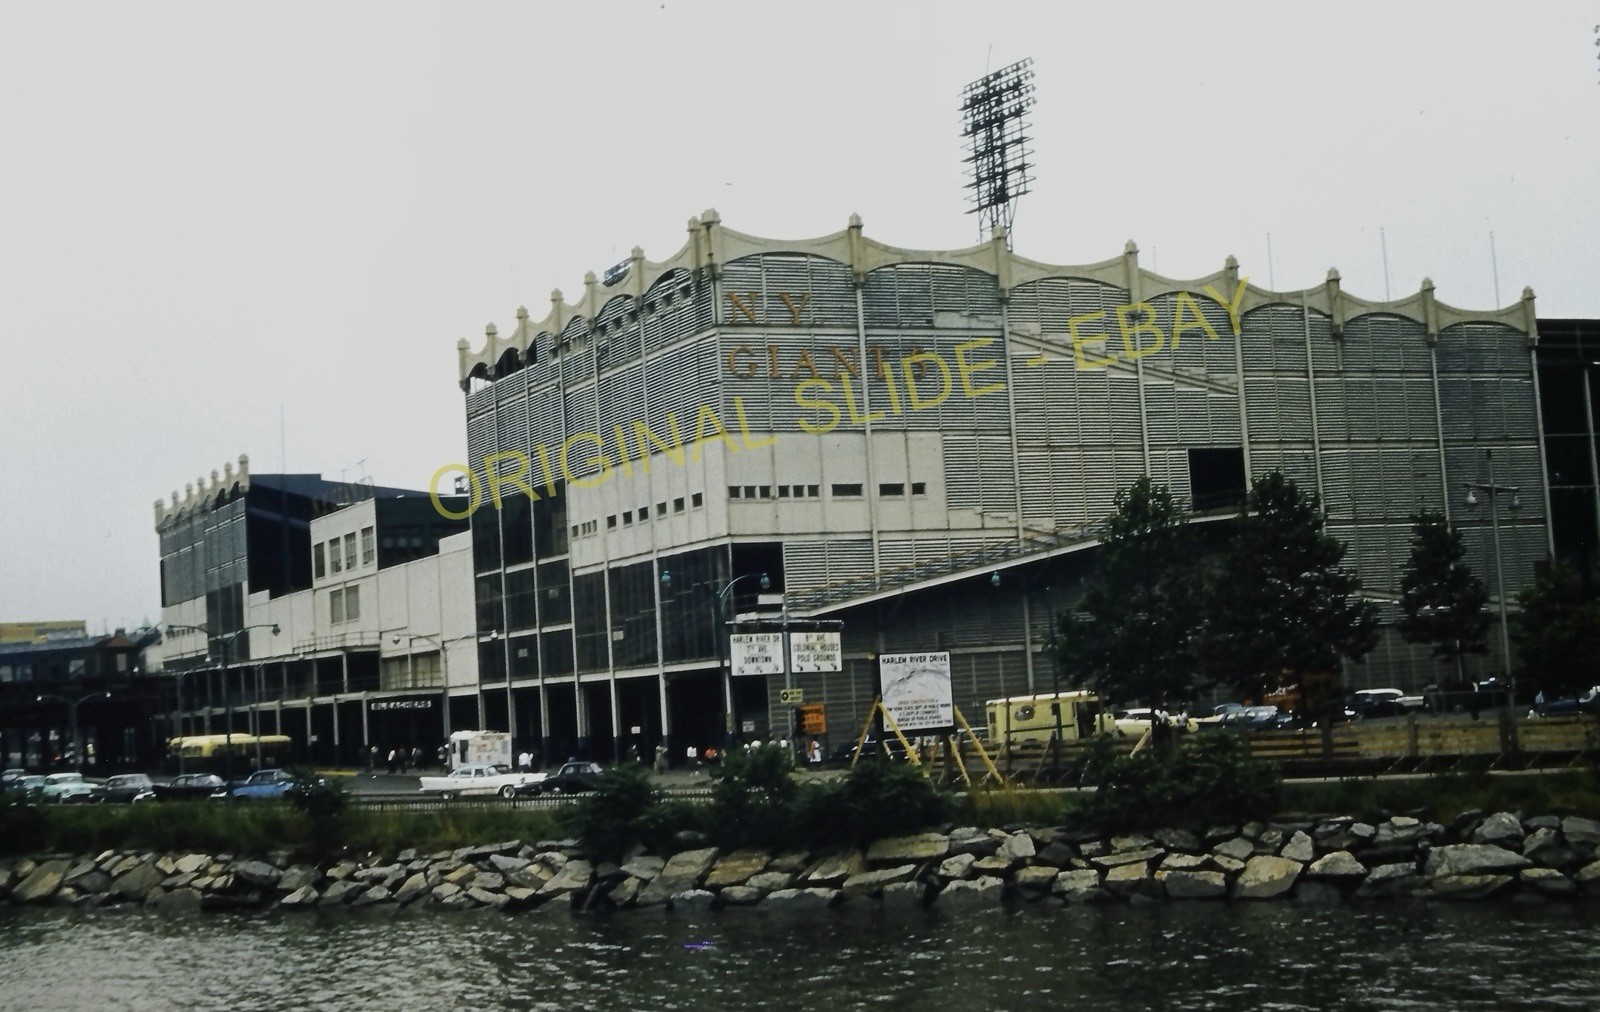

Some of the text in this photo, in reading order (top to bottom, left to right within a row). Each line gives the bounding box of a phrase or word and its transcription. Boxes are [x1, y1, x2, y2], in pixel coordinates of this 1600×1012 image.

[728, 344, 927, 380] GIANTS
[882, 654, 947, 664] HARLEM RIVER DRIVE
